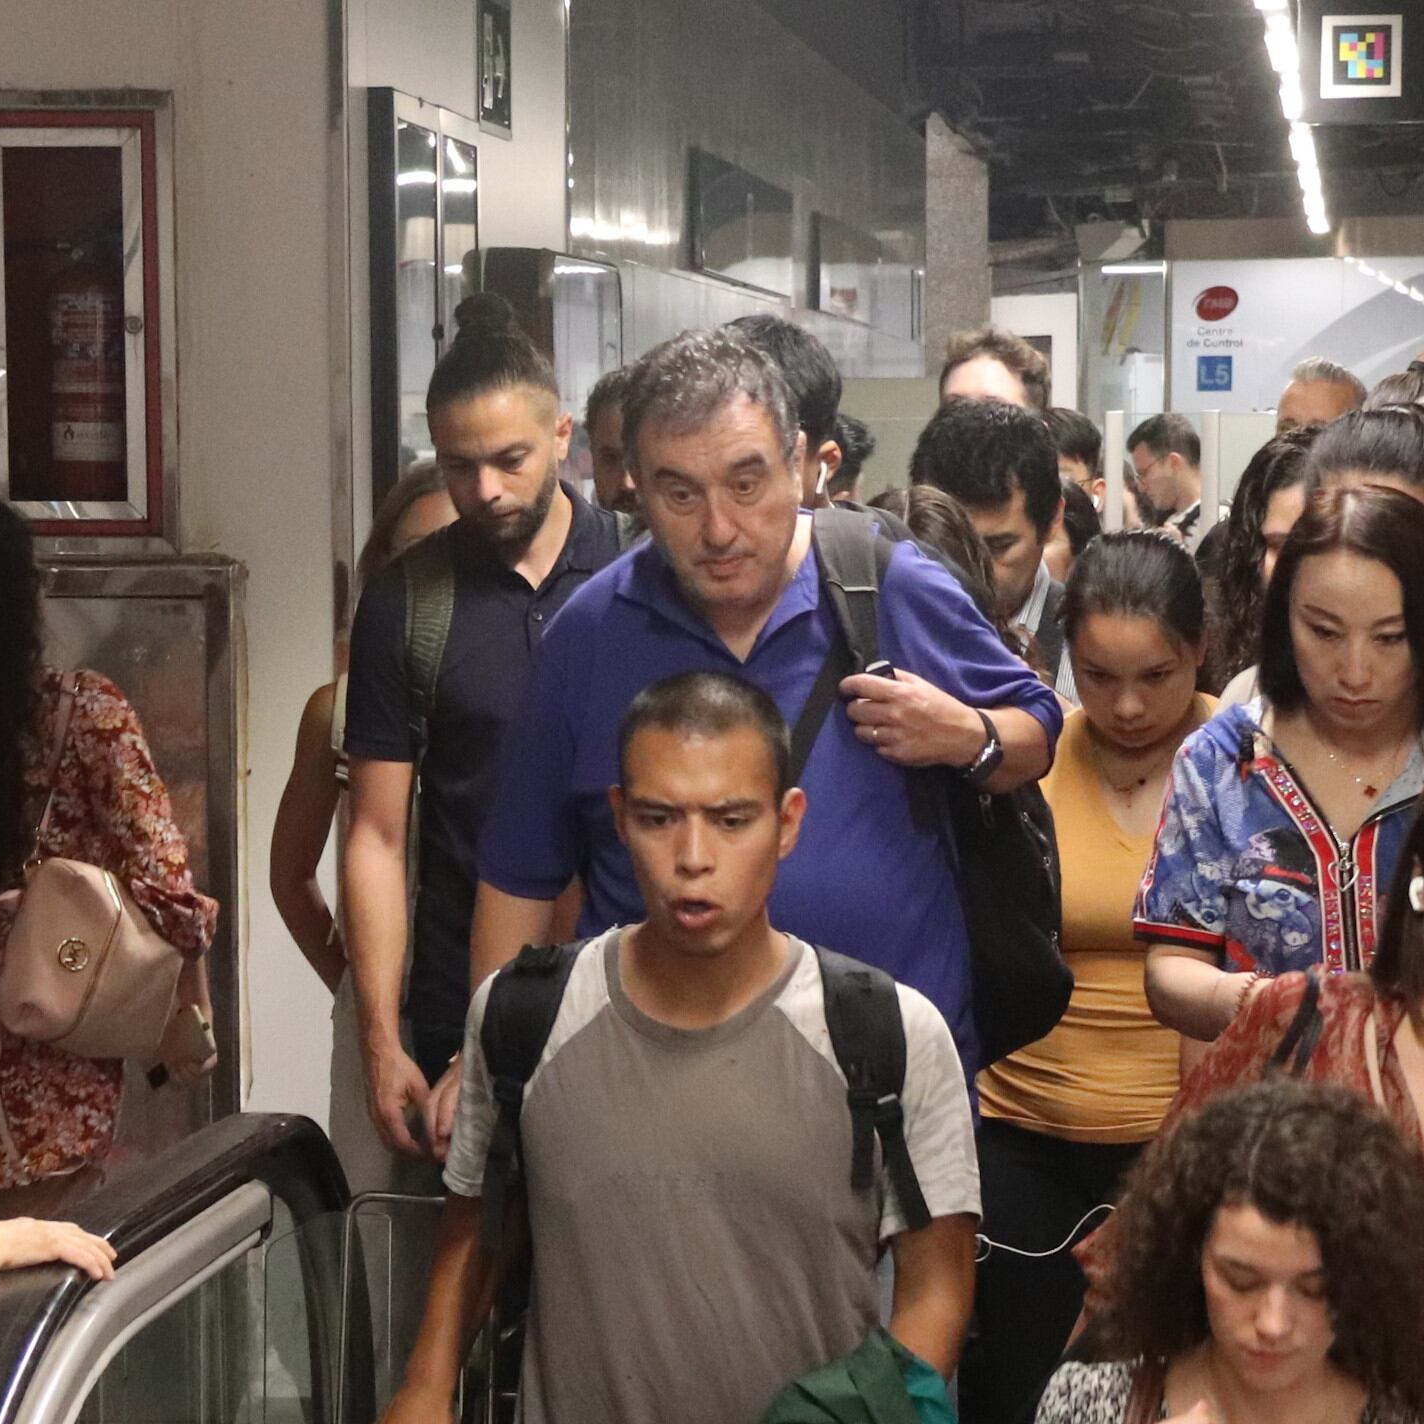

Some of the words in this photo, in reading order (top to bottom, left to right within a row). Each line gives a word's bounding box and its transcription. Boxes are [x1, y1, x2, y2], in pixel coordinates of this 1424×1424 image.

[1197, 327, 1233, 337] Centre
[1186, 339, 1200, 348] de
[1203, 338, 1243, 348] Control
[1200, 364, 1230, 385] L5
